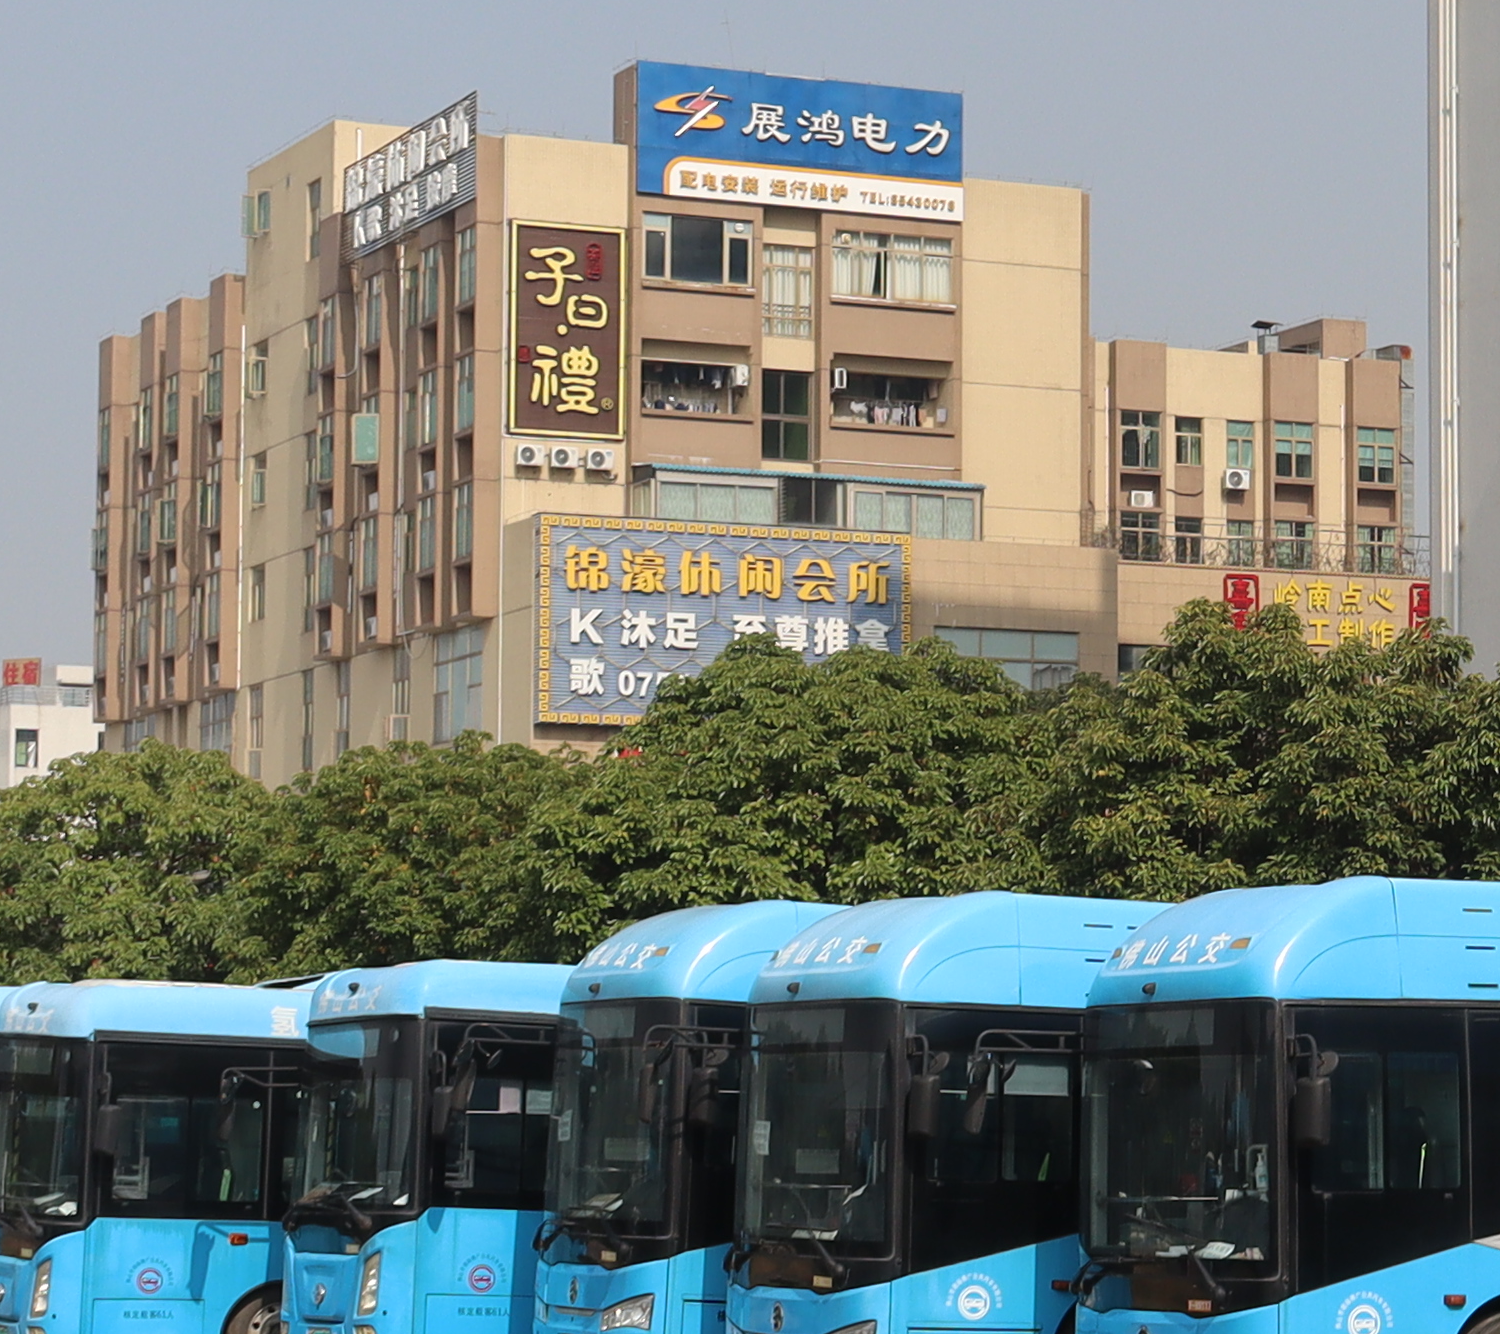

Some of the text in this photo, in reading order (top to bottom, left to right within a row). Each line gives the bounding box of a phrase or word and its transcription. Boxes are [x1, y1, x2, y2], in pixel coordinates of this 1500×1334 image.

[741, 101, 950, 156] 展鸿电力
[679, 169, 760, 195] 配电安装
[769, 178, 849, 204] 运行维护
[564, 543, 891, 606] 锦濠休闲会所
[1273, 578, 1397, 614] 岭南点心
[569, 607, 890, 656] K 沐足 至尊推拿
[569, 658, 605, 696] 歌
[1117, 932, 1232, 970] 佛山公交
